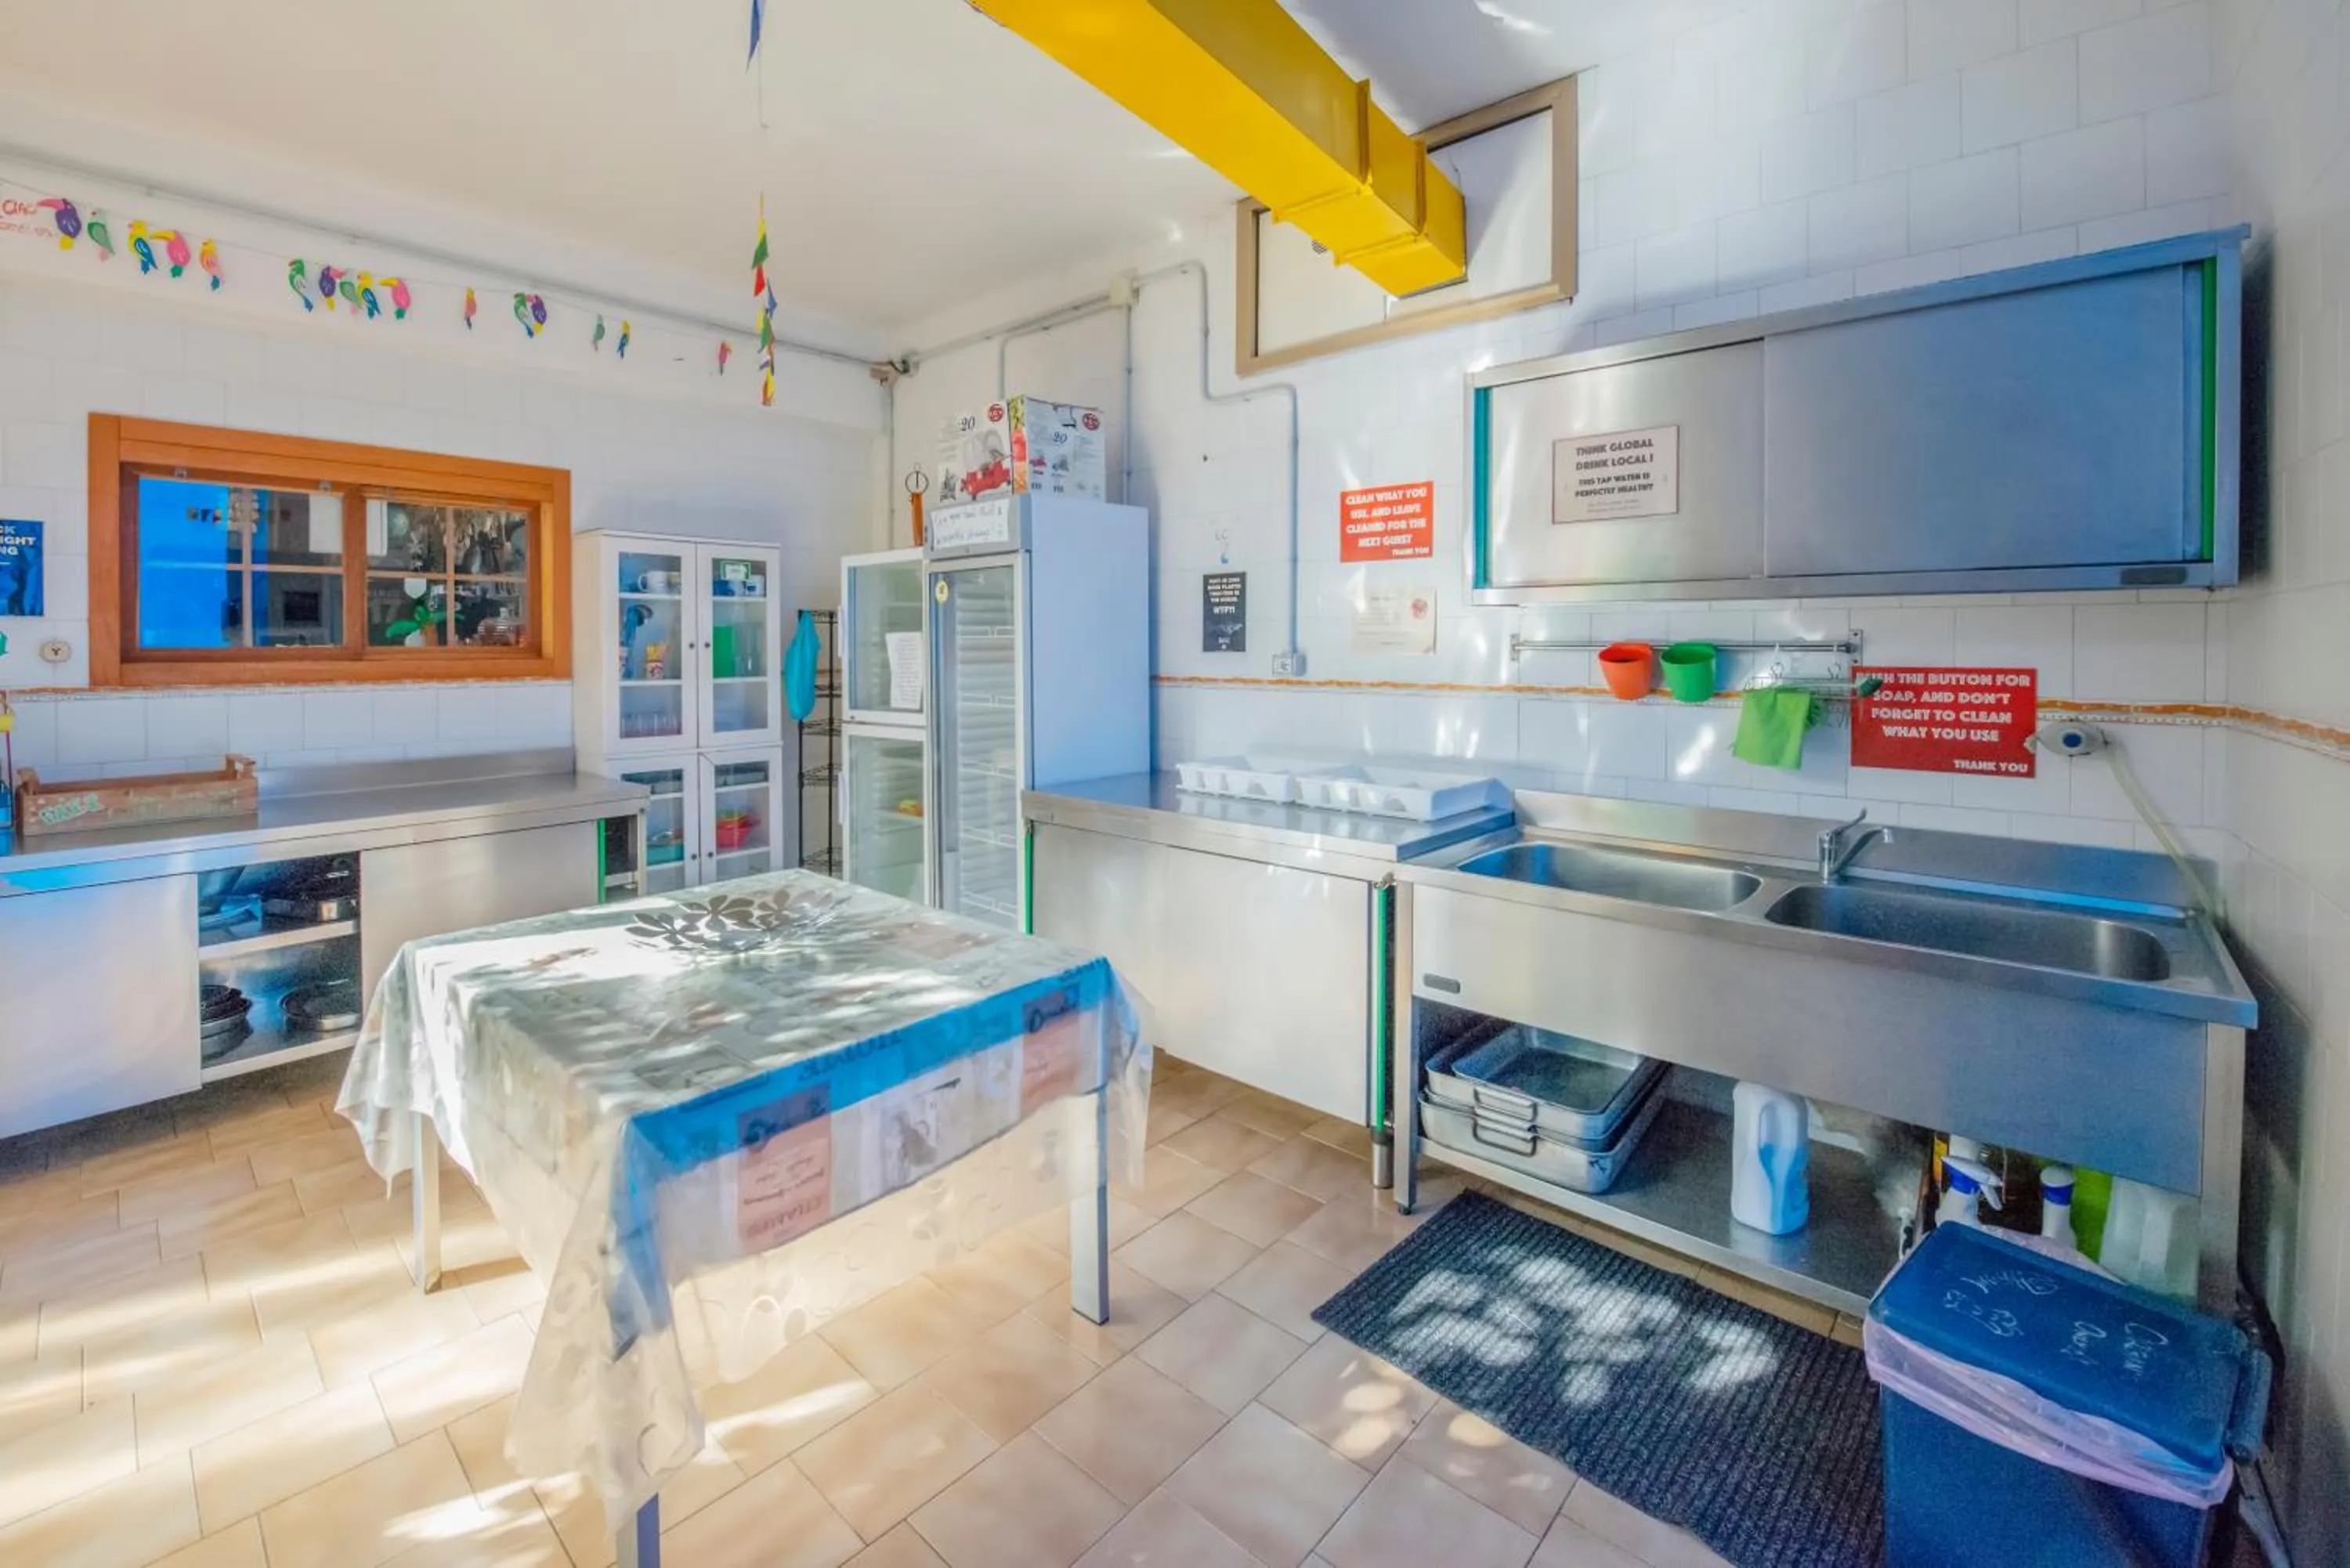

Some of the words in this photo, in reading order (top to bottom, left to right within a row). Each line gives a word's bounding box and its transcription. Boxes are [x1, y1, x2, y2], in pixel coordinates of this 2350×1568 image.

[1576, 444, 1607, 457] THINK
[1609, 439, 1654, 452] GLOBAL
[1576, 458, 1608, 470] DRINK
[1611, 454, 1647, 467] LOCAL
[1597, 476, 1611, 485] TAP
[1614, 473, 1640, 482] WATER
[1346, 494, 1374, 505] CLEAN
[1375, 490, 1404, 502] WHAT
[1406, 487, 1426, 498] YOU
[1575, 486, 1615, 497] PERFECTLY
[1618, 483, 1654, 493] HEALTHY
[1372, 507, 1391, 517] AND
[1393, 503, 1421, 515] LEAVE
[1346, 522, 1385, 533] CLEANED
[1387, 519, 1407, 530] FOR
[1408, 518, 1426, 529] THE
[1358, 537, 1381, 547] NEXT
[1383, 534, 1412, 545] GUEST
[1897, 674, 1925, 684] THE
[1928, 674, 1993, 685] BUTTON
[1996, 675, 2030, 686] FOR
[1873, 690, 1916, 703] SOAP,
[1921, 692, 1954, 703] AND
[1958, 692, 2011, 704] DON'T
[1871, 707, 1930, 721] FORGET
[1933, 709, 1955, 721] TO
[1959, 711, 2012, 724] CLEAN
[1882, 725, 1928, 739] WHAT
[1931, 727, 1966, 740] YOU
[1970, 730, 1999, 742] USE
[1954, 759, 1997, 771] THANK
[1999, 761, 2028, 772] YOU
